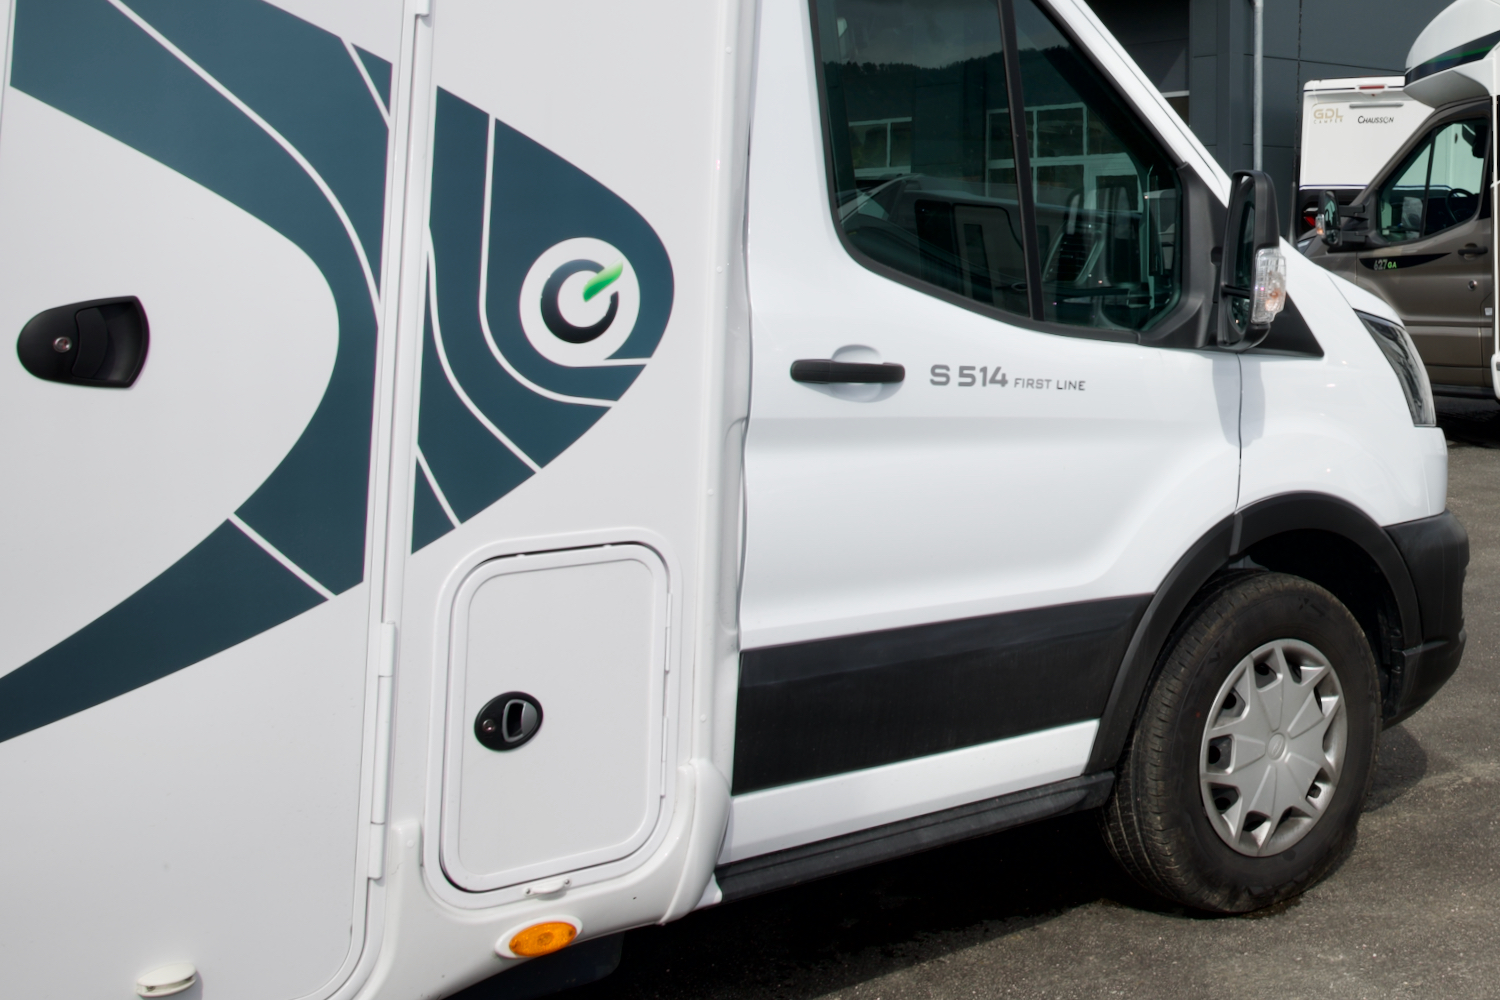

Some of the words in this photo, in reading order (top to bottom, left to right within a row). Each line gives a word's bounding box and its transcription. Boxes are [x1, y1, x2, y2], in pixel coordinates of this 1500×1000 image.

[1313, 107, 1344, 119] GDL
[929, 364, 951, 387] S
[957, 365, 1009, 388] 514
[1013, 377, 1052, 390] FIRST
[1056, 379, 1086, 391] LINE
